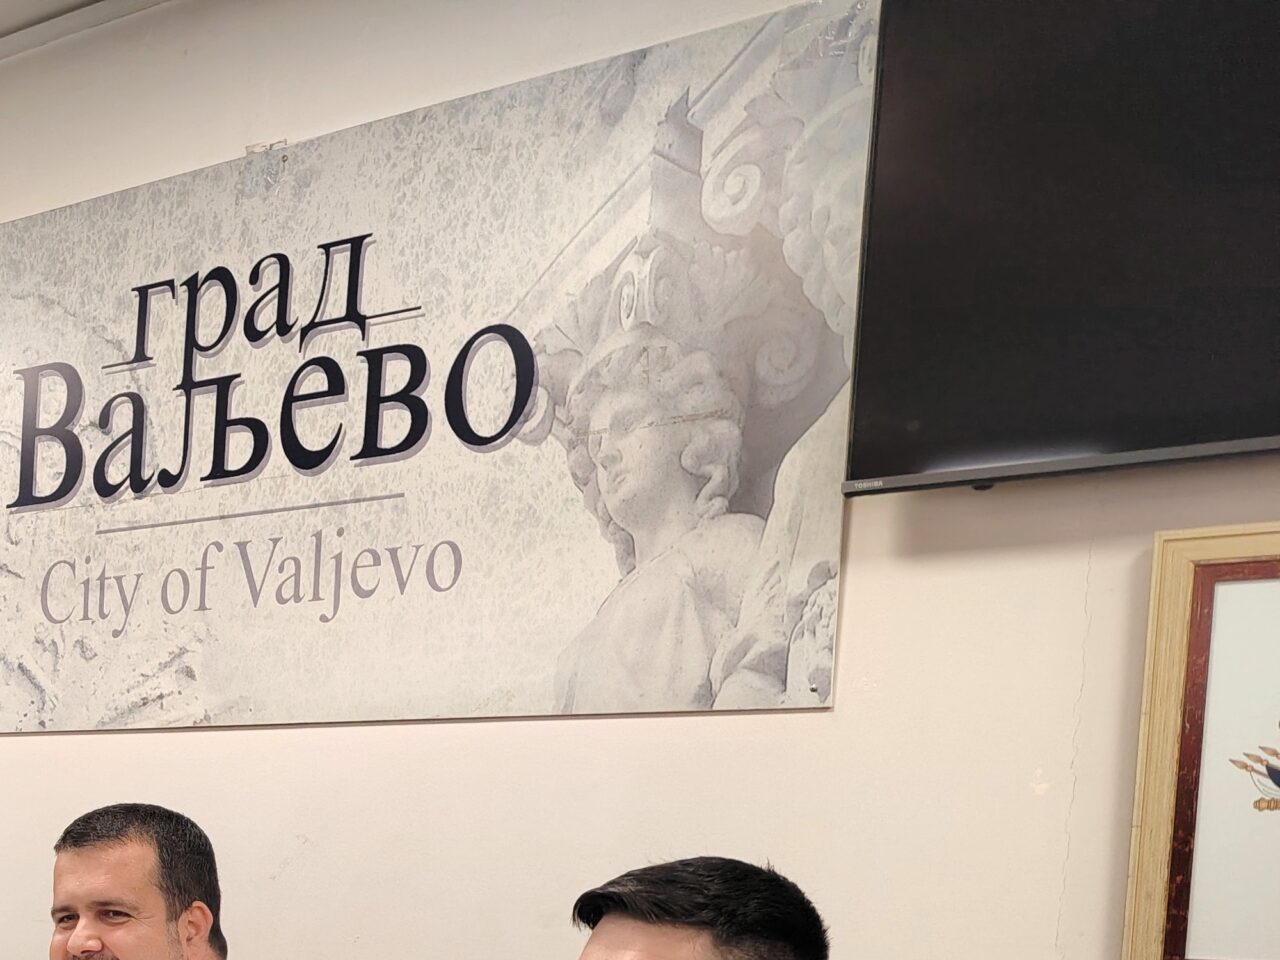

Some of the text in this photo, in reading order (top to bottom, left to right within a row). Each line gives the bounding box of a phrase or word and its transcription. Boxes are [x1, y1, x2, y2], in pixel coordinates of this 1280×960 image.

[124, 232, 386, 391] град
[5, 322, 540, 513] Ваљево
[40, 526, 464, 638] City of Valjevo
